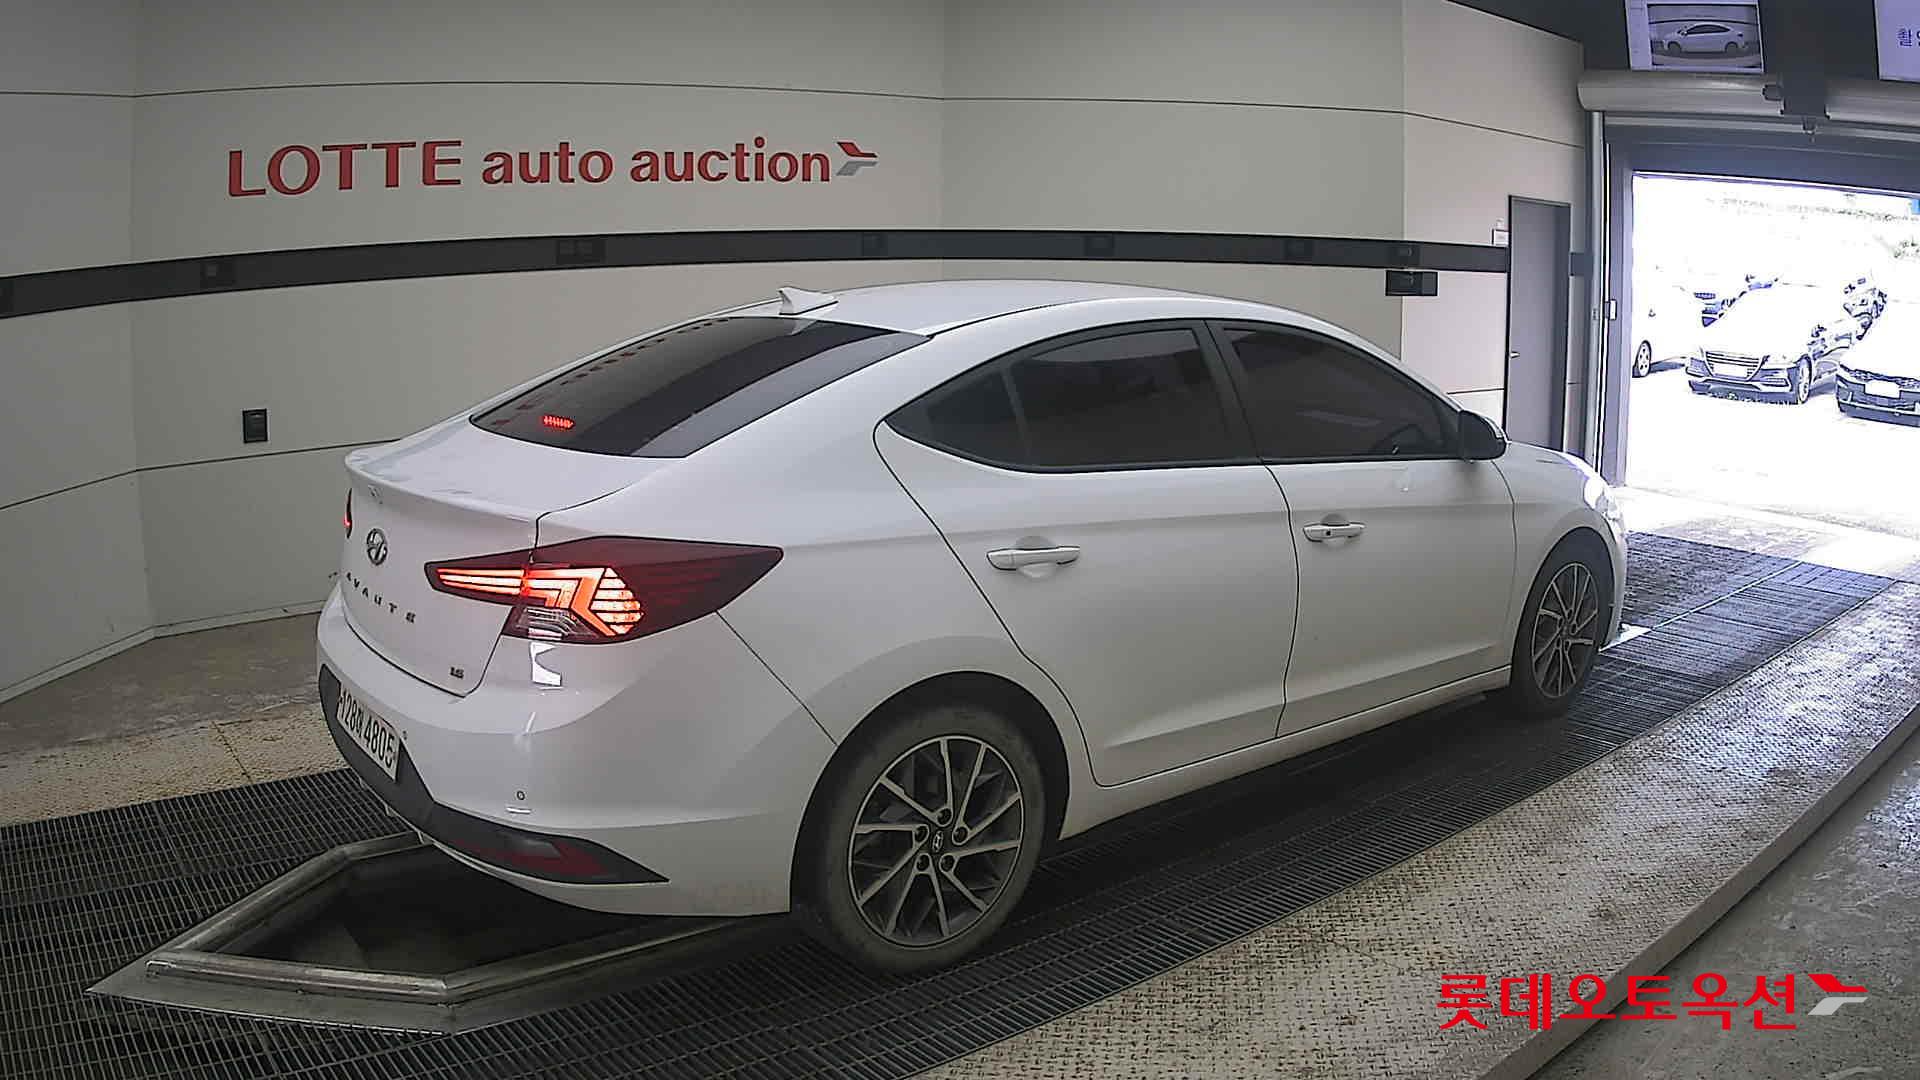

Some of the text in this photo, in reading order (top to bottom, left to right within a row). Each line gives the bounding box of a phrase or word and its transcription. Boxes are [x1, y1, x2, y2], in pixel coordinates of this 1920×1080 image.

[228, 135, 831, 198] LOTTE auto auction
